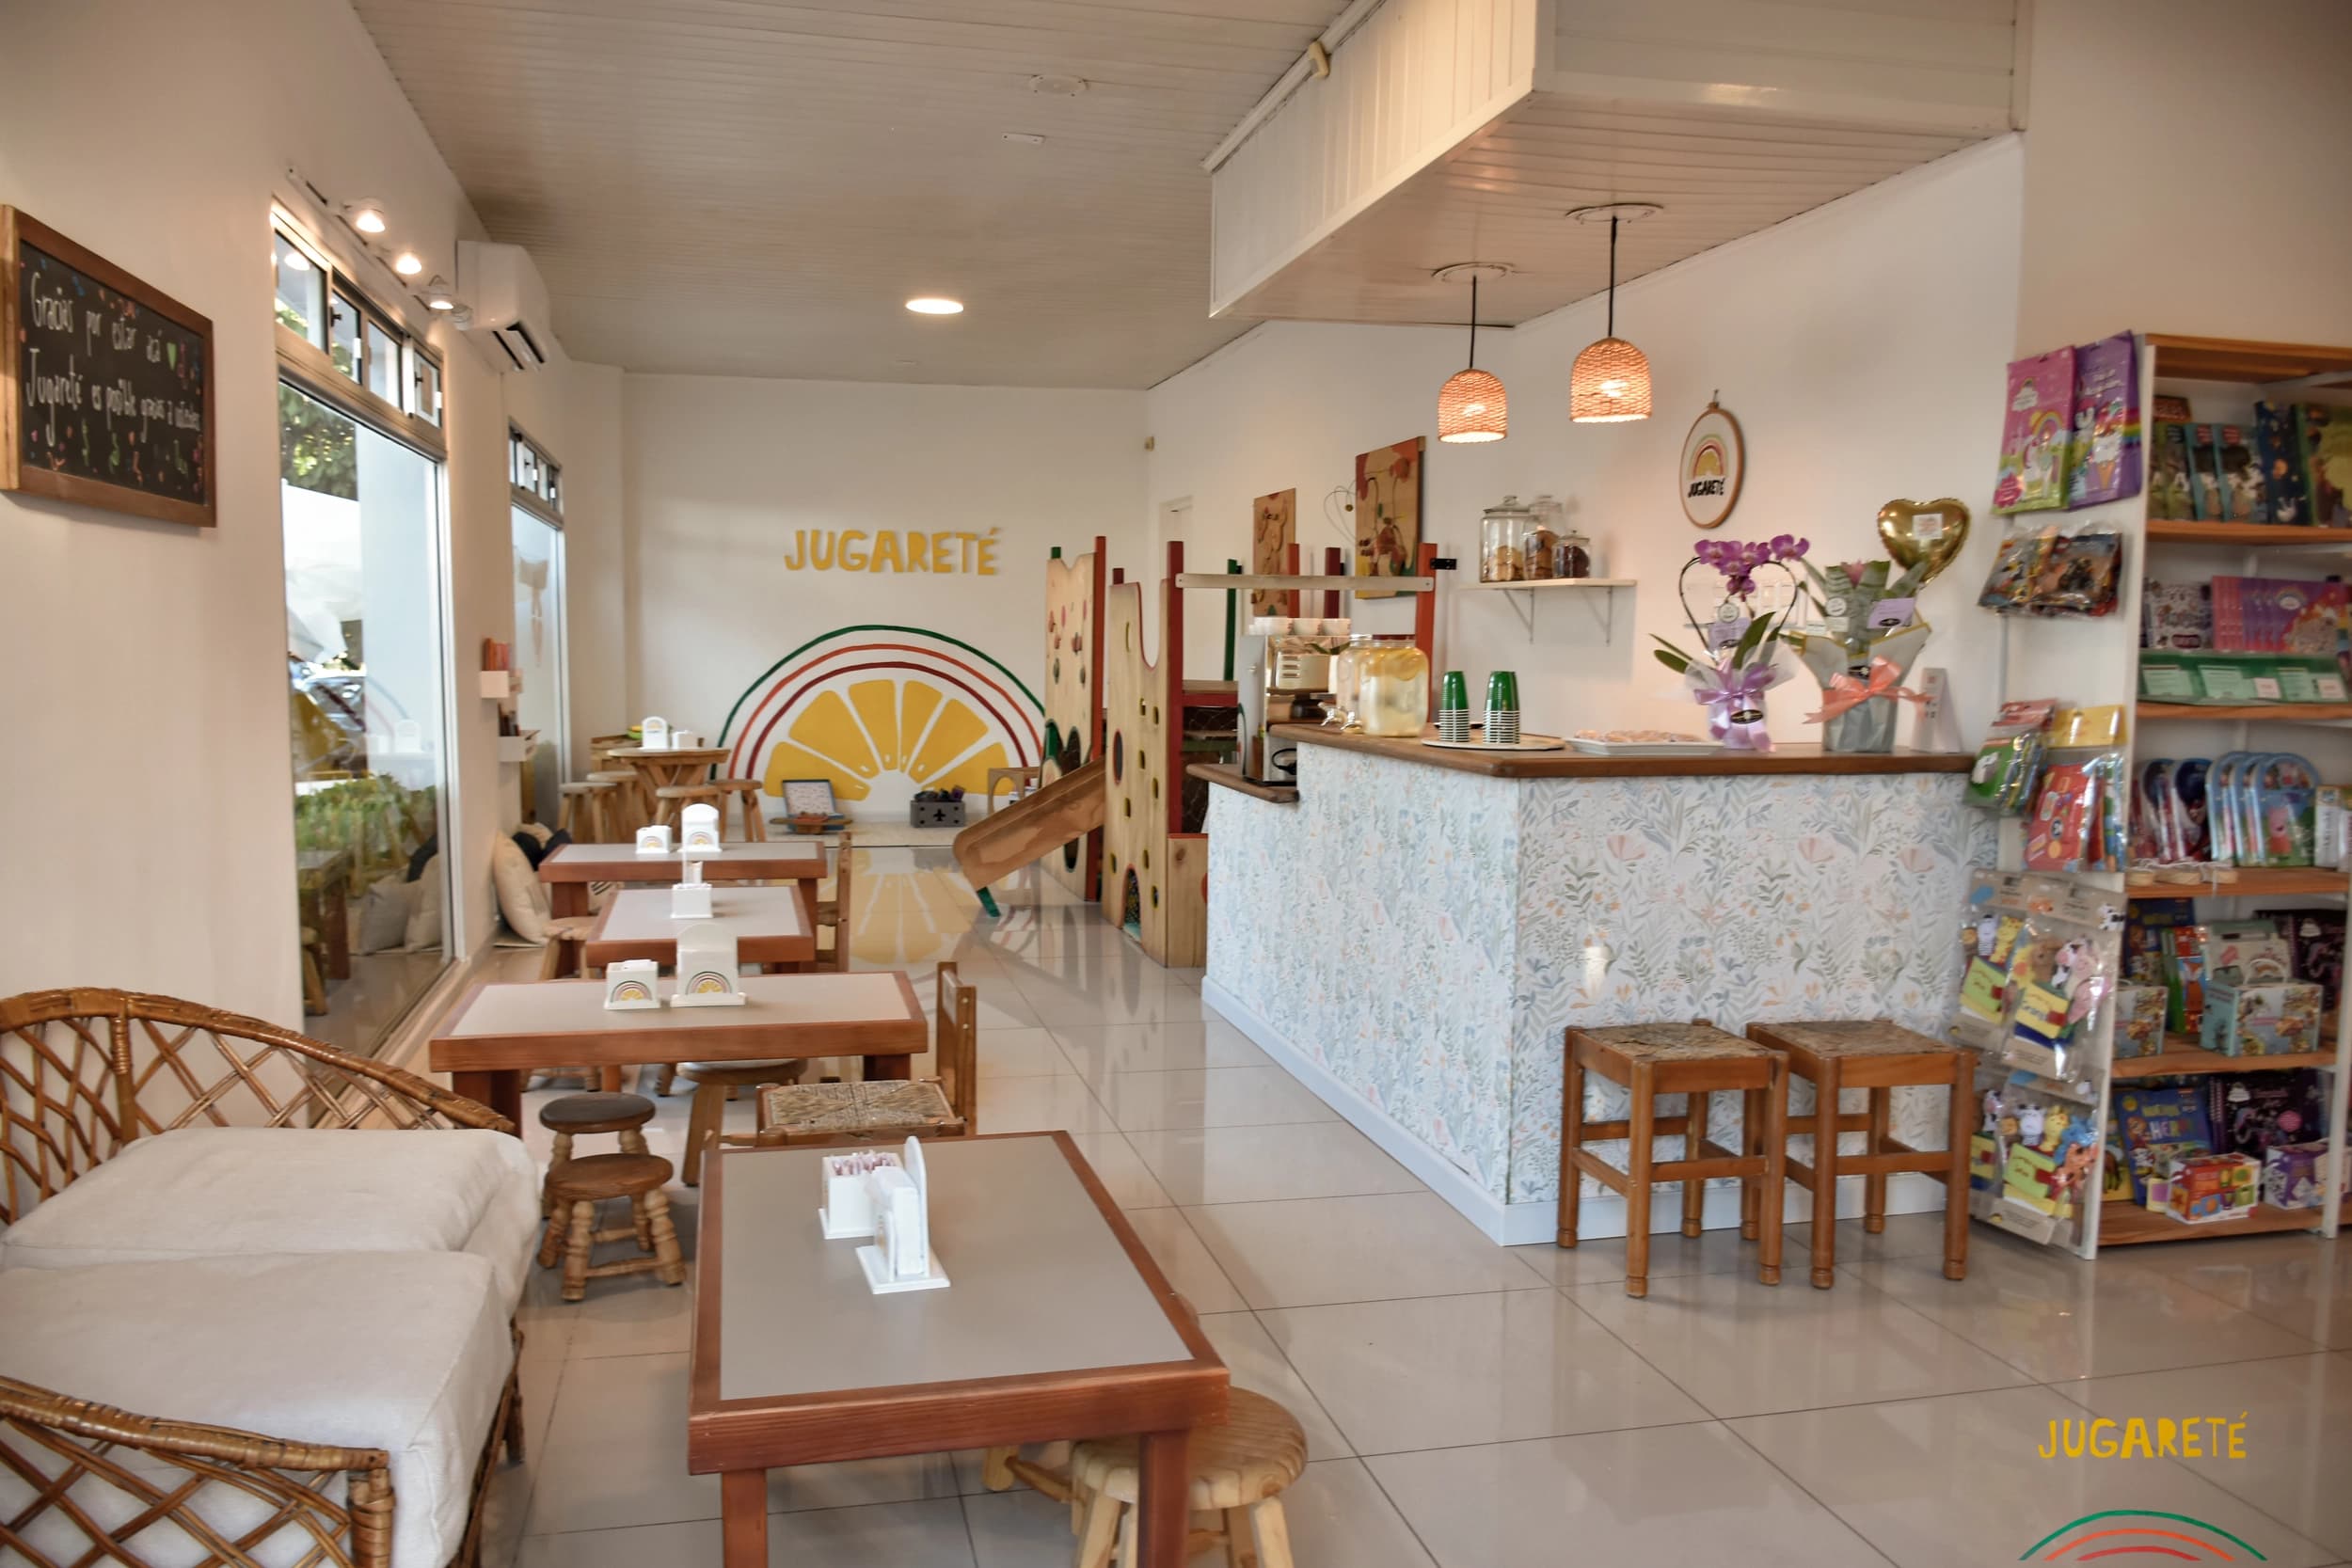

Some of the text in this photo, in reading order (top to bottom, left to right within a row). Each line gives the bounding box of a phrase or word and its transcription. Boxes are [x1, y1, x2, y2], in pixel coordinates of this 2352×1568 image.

[30, 271, 73, 333] Gracias
[86, 310, 102, 356] por
[25, 347, 84, 448] Jugareté
[784, 527, 1002, 576] JUGARETÉ
